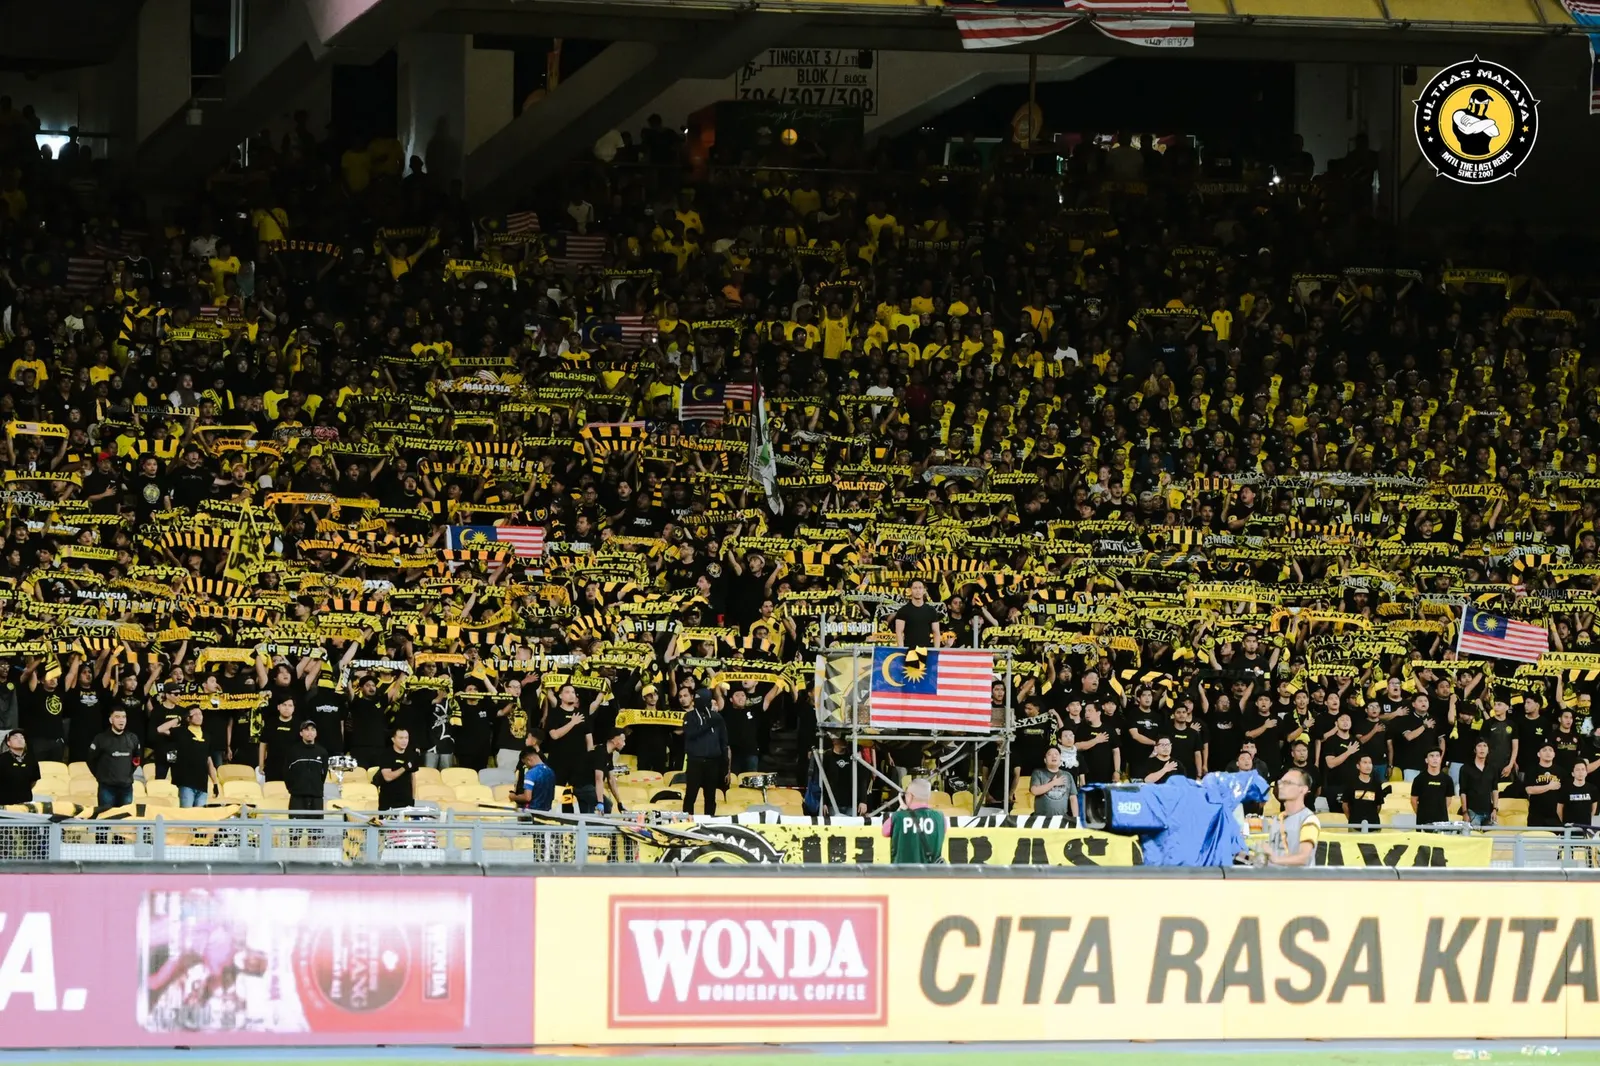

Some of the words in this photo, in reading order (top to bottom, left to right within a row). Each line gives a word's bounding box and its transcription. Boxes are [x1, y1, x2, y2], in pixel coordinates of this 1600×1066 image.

[769, 50, 820, 65] TINGKAT
[824, 50, 832, 64] 3
[835, 50, 841, 64] /
[797, 69, 828, 83] BLOK
[832, 69, 838, 83] /
[844, 75, 867, 83] BLOCK
[1145, 308, 1198, 316] MALAYSIA
[459, 357, 505, 366] MALAYSIA
[550, 372, 597, 382] MALAYSIA
[463, 383, 511, 393] MALAYSIA
[373, 421, 426, 430] MALAYSIA
[323, 442, 380, 454] MALAYSIA
[16, 470, 72, 480] MALAYSIA
[777, 474, 832, 486] MALAYSIA
[837, 481, 886, 491] MALAYSIA
[1451, 484, 1506, 497] MALAYSIA
[885, 533, 922, 542] MALAYSIA
[73, 545, 112, 554] MALAYSIA
[885, 570, 932, 580] MALAYSIA
[76, 589, 128, 600] MALAYSIA
[1191, 586, 1255, 595] MALAYSIA
[1255, 593, 1276, 602] YSIA
[791, 604, 847, 616] MALAYSIA
[44, 625, 116, 638] MALAYSIA
[1106, 627, 1174, 643] MALAYSIA
[724, 672, 768, 681] MALAYSIA
[1117, 802, 1141, 815] astro
[0, 911, 88, 1011] A.
[628, 919, 868, 1002] WONDA
[918, 915, 1117, 1006] CITA
[1146, 915, 1386, 1005] RASA
[1415, 916, 1600, 1004] KITA
[698, 985, 798, 1001] WONDERFUL
[804, 984, 867, 1001] COFFEE
